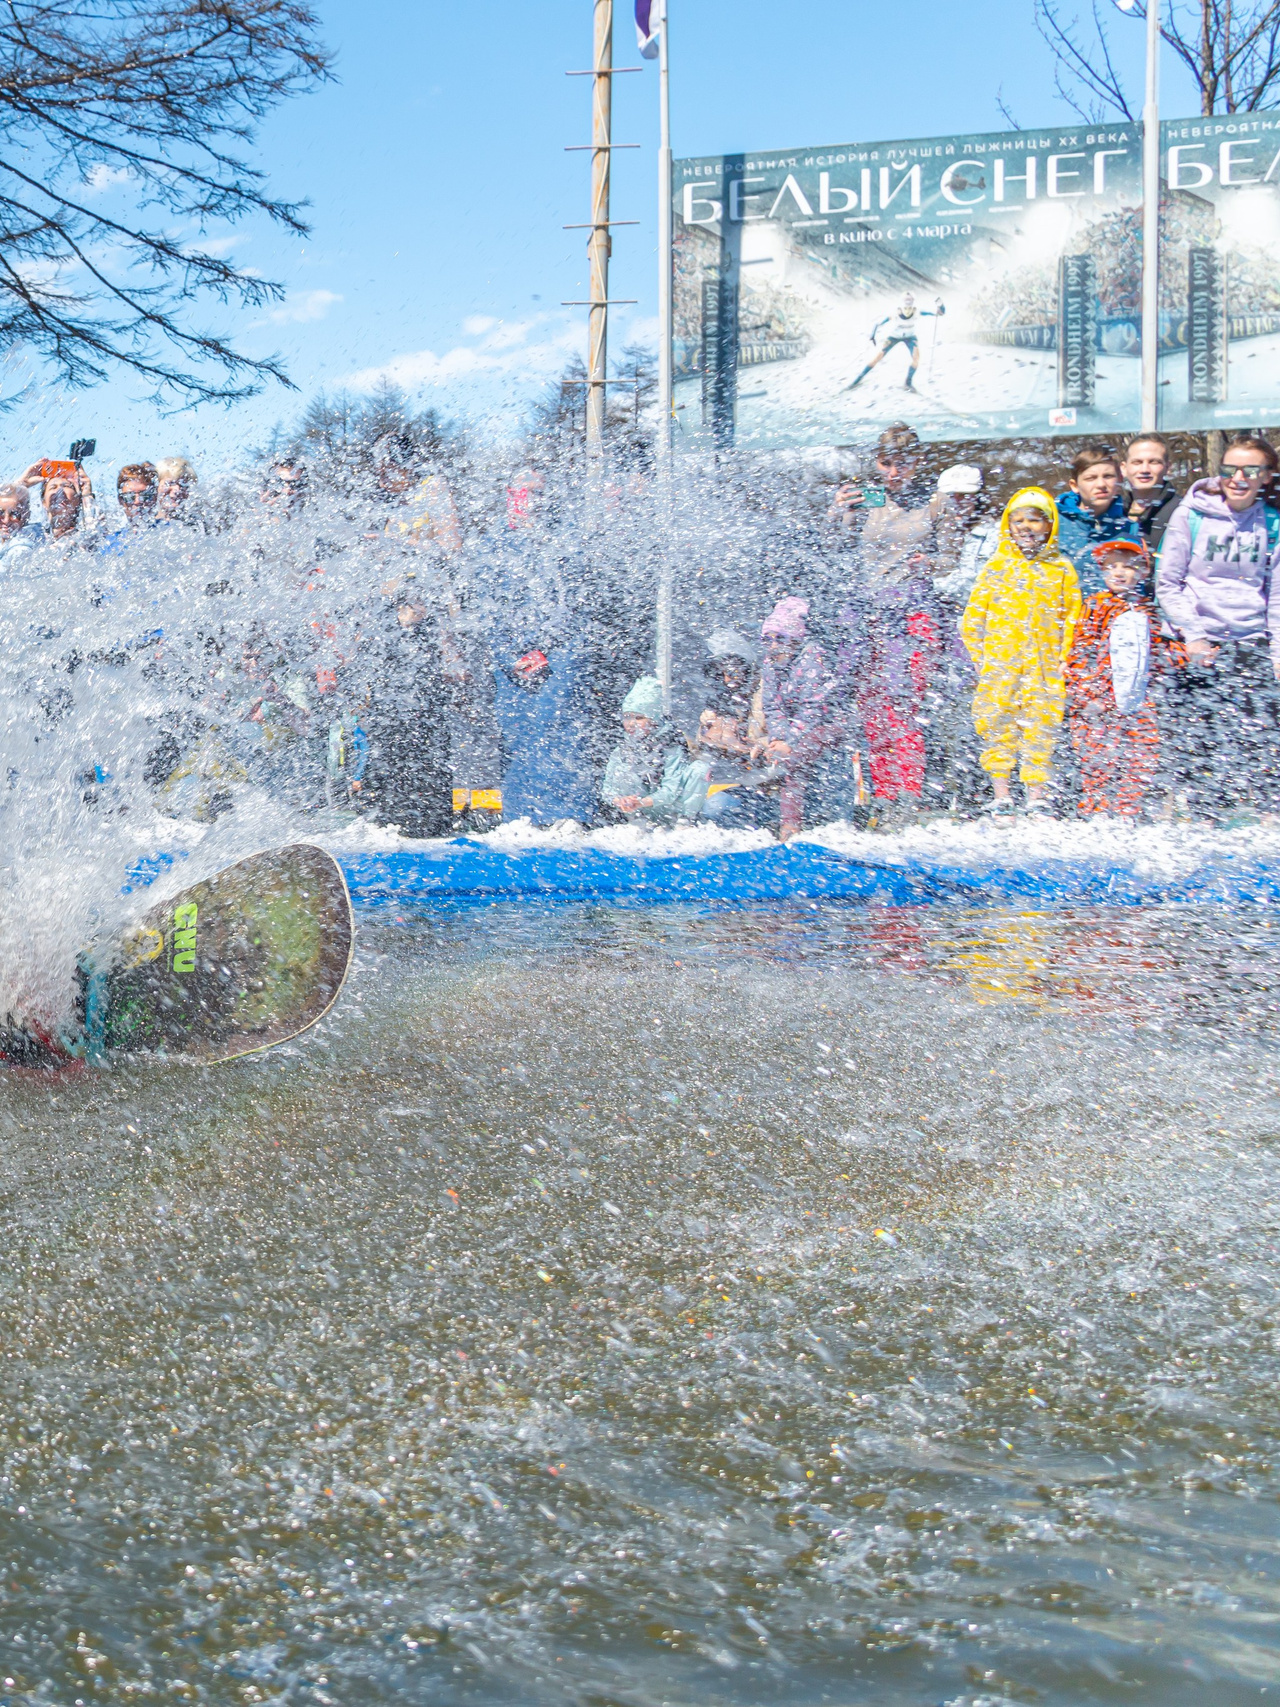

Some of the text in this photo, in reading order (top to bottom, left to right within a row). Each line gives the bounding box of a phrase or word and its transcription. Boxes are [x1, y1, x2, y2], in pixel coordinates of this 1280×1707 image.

[683, 158, 797, 177] НЕВЕРОЯТНАЯ
[804, 150, 879, 167] ИСТОРИЯ
[887, 143, 955, 159] ЛУЧШЕЙ
[963, 137, 1051, 154] ЛЫЖНИЦЫ
[1086, 131, 1129, 145] ВЕКА
[683, 149, 1128, 225] БЕЛЫЙ СНЕГ
[902, 225, 914, 240] 4
[706, 284, 719, 317] 1997
[1066, 257, 1082, 404] TRONDHEIM 1997
[1193, 252, 1209, 401] TRONDHEIM 1997
[173, 902, 198, 973] GNU
